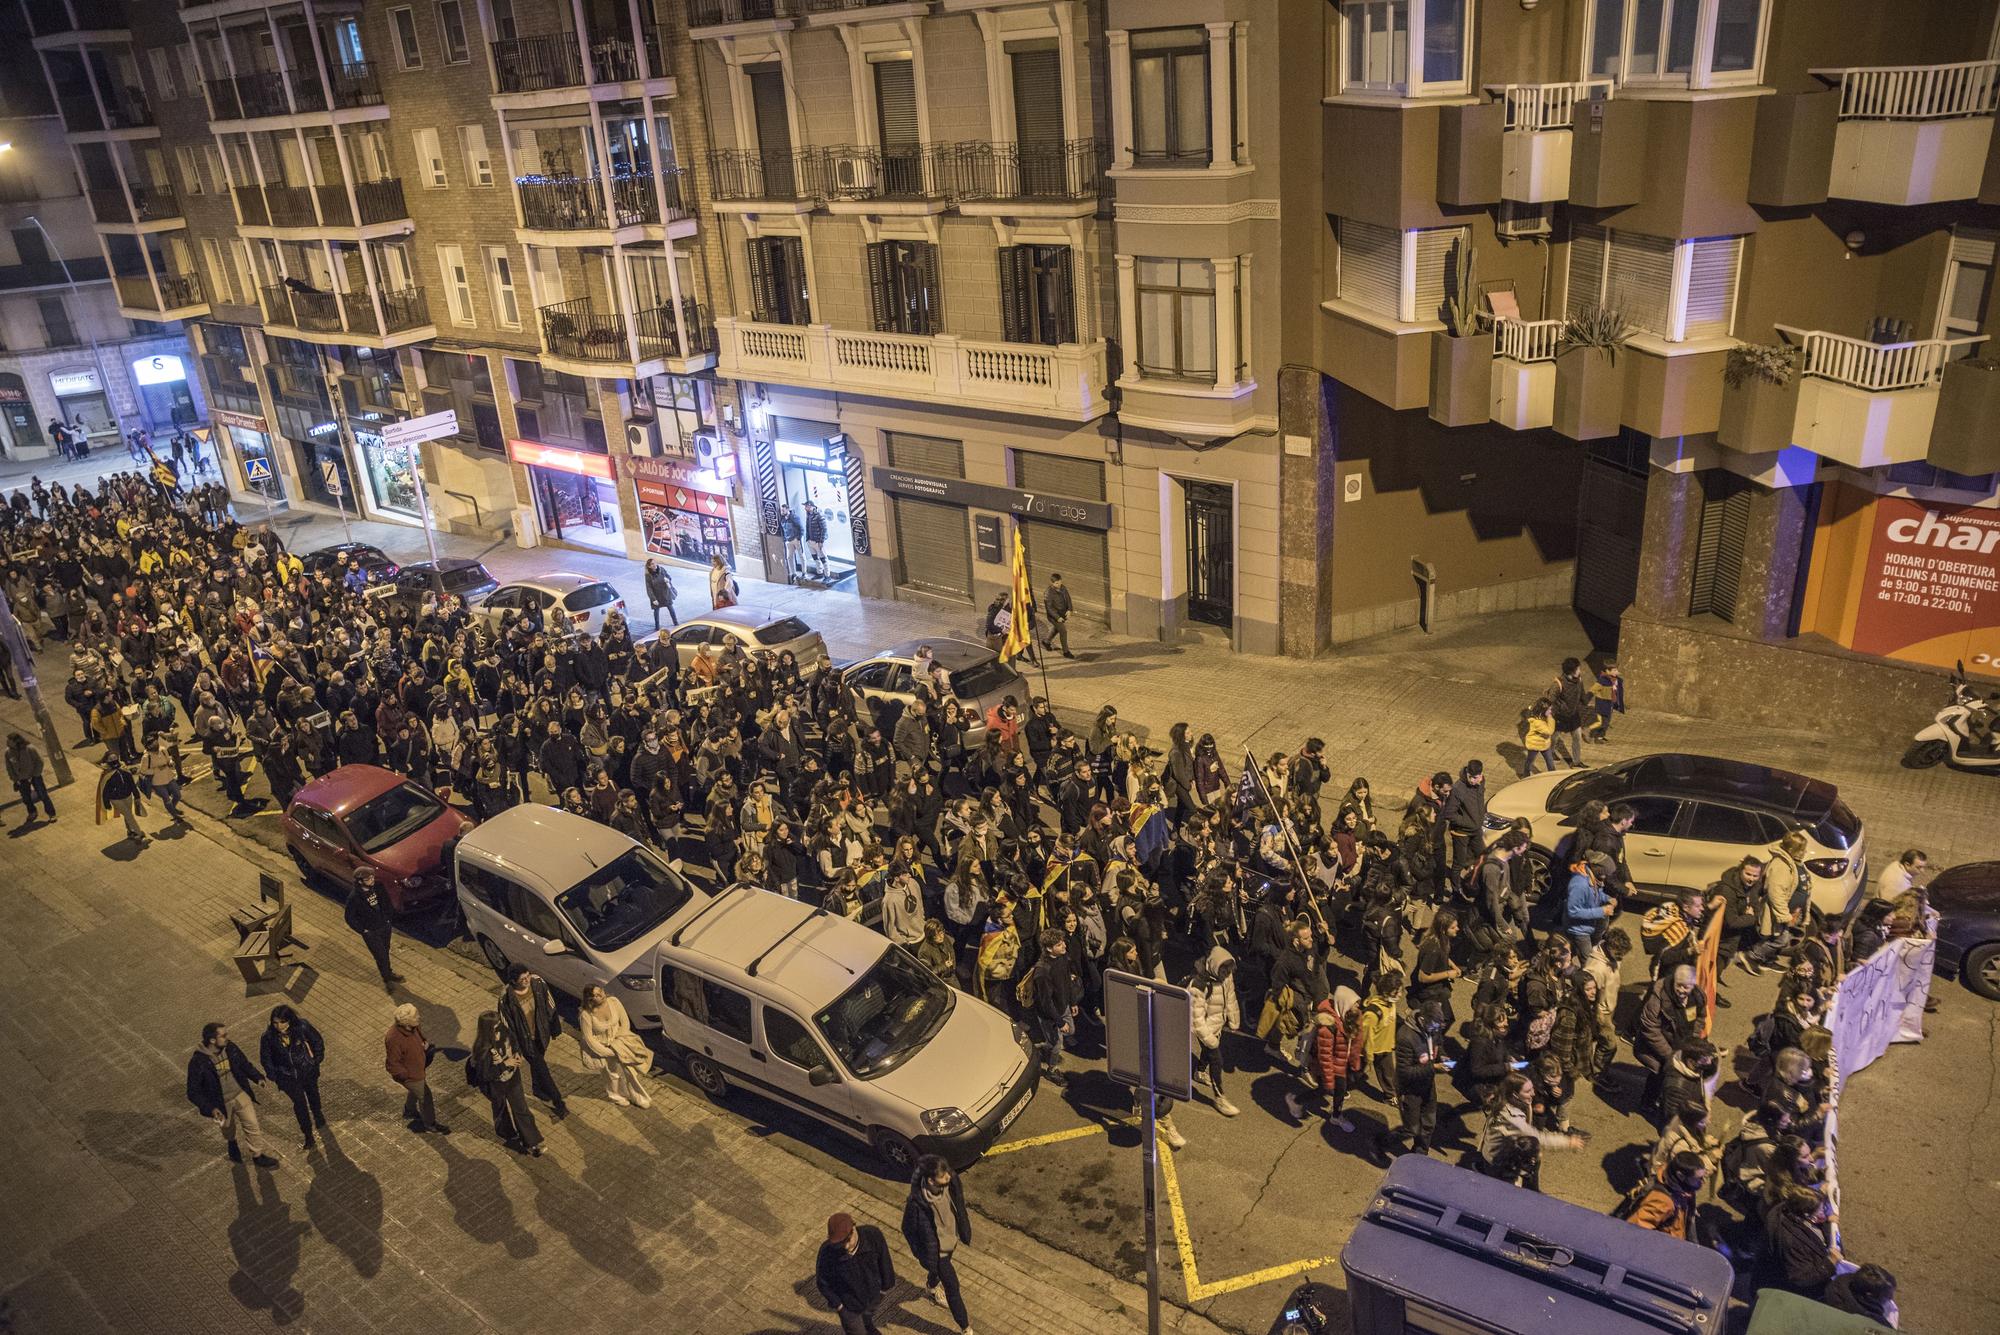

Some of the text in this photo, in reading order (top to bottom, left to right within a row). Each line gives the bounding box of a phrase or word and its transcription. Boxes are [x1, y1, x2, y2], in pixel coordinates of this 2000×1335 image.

[309, 423, 338, 436] TATTOO
[385, 427, 402, 435] Sortida
[402, 433, 427, 444] direccions
[639, 460, 687, 481] SALÓ DE JOC
[889, 474, 947, 488] CREACIONS AUDIOVISUALS
[897, 481, 914, 490] SERVEIS
[1011, 503, 1024, 511] Grup
[1024, 493, 1034, 511] 7
[1887, 510, 2000, 553] char
[1885, 553, 1996, 578] HORARI D'OBERTURA
[1883, 565, 2000, 592] DILLUNS A DIUMENGE
[1881, 578, 1893, 588] de
[1896, 580, 1919, 592] 9:00
[1921, 585, 1928, 594] a
[1931, 585, 1959, 598] 15:00
[1961, 590, 1970, 601] h.
[1878, 590, 1974, 614] de 17:00 a 22:00 h.
